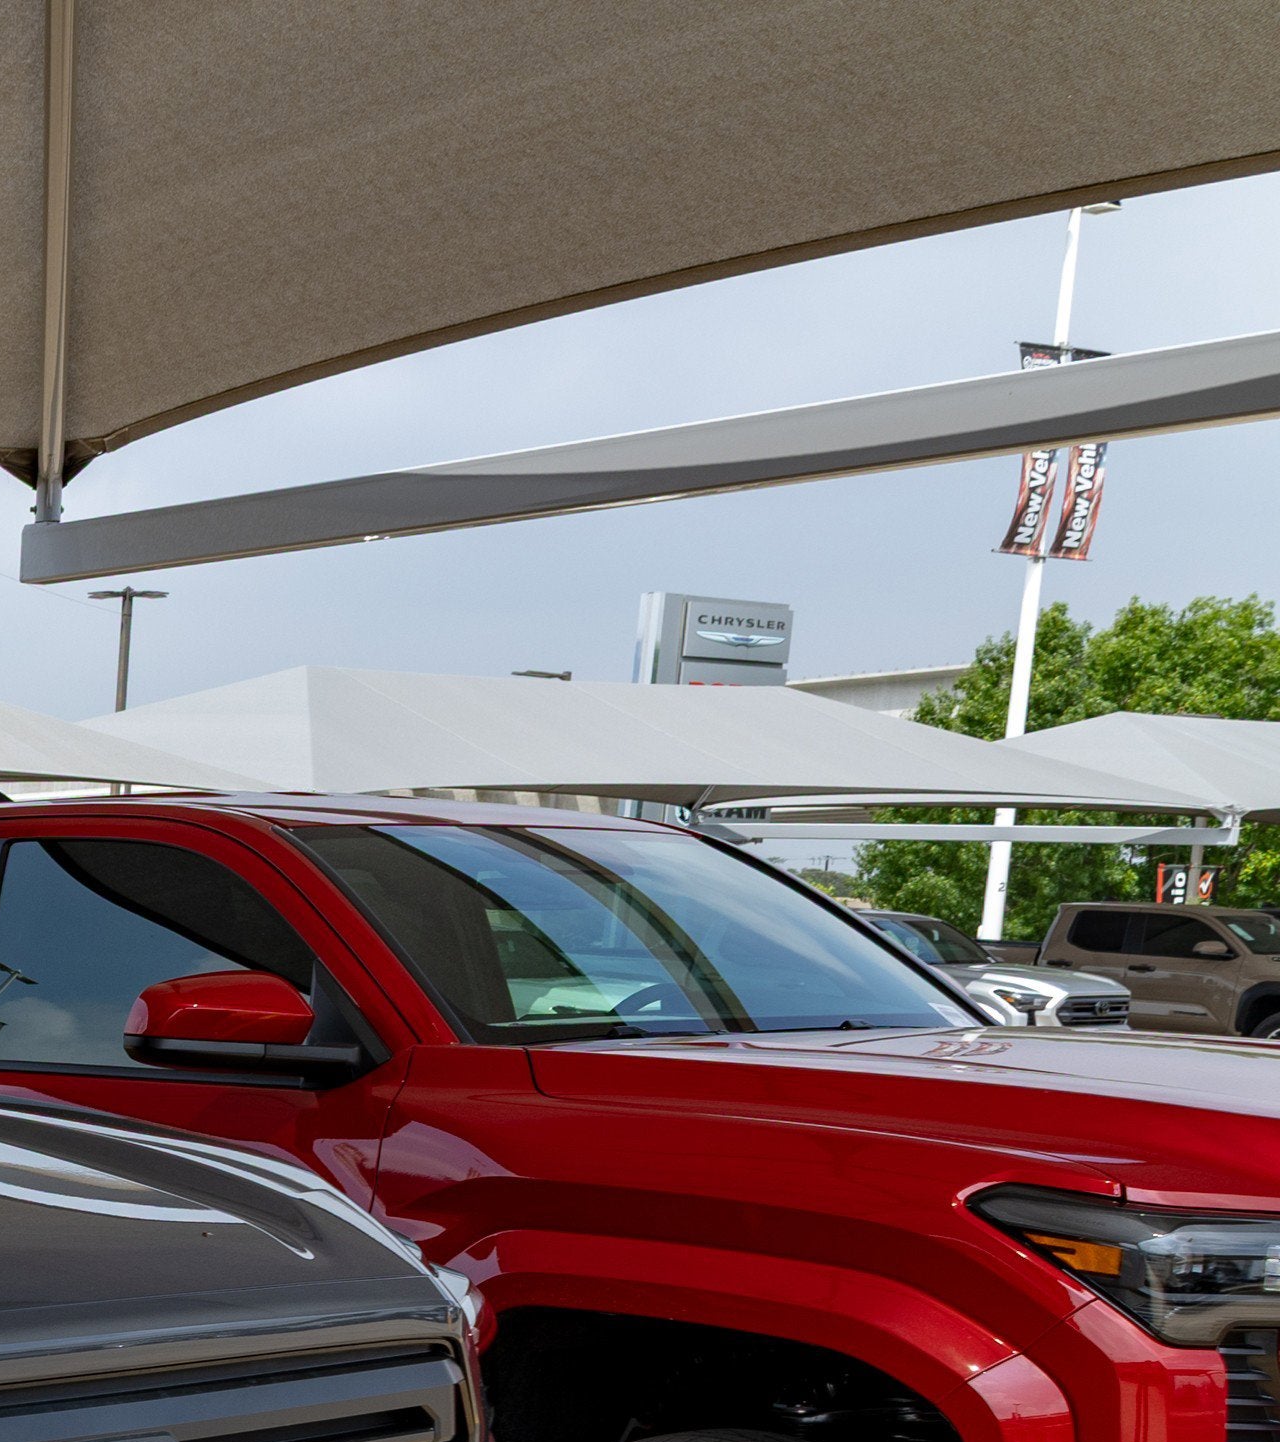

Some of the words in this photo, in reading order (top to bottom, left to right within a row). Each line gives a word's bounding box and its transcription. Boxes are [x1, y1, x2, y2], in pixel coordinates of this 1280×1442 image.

[1014, 492, 1044, 543] New
[1062, 497, 1090, 548] New
[697, 614, 786, 631] CHRYSLER
